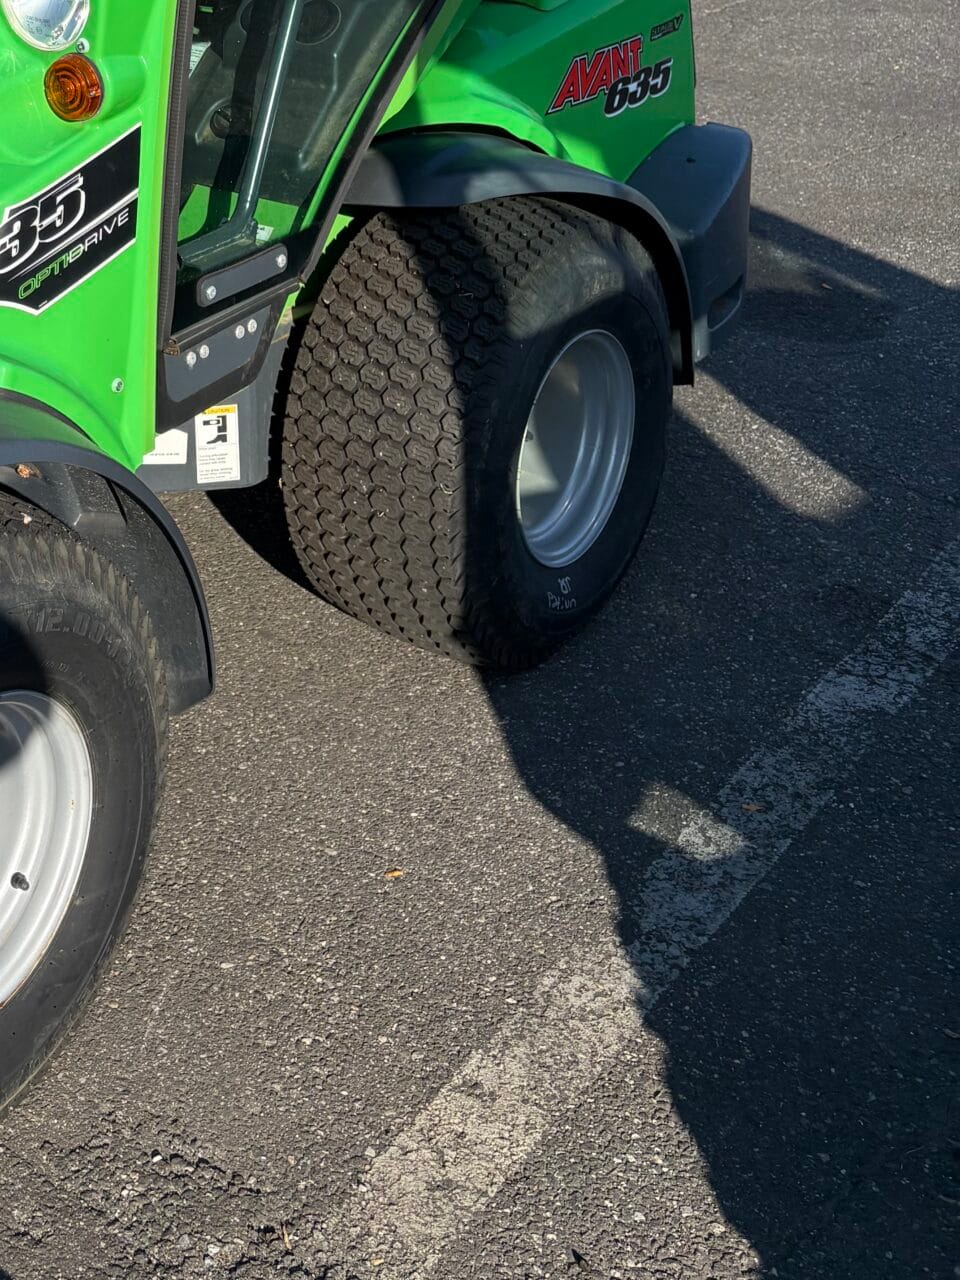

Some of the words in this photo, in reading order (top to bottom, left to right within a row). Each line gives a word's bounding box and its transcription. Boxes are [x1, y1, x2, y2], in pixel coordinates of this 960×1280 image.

[545, 33, 643, 116] AVANT
[604, 57, 673, 117] 635
[18, 207, 130, 300] OPTIDRIVE
